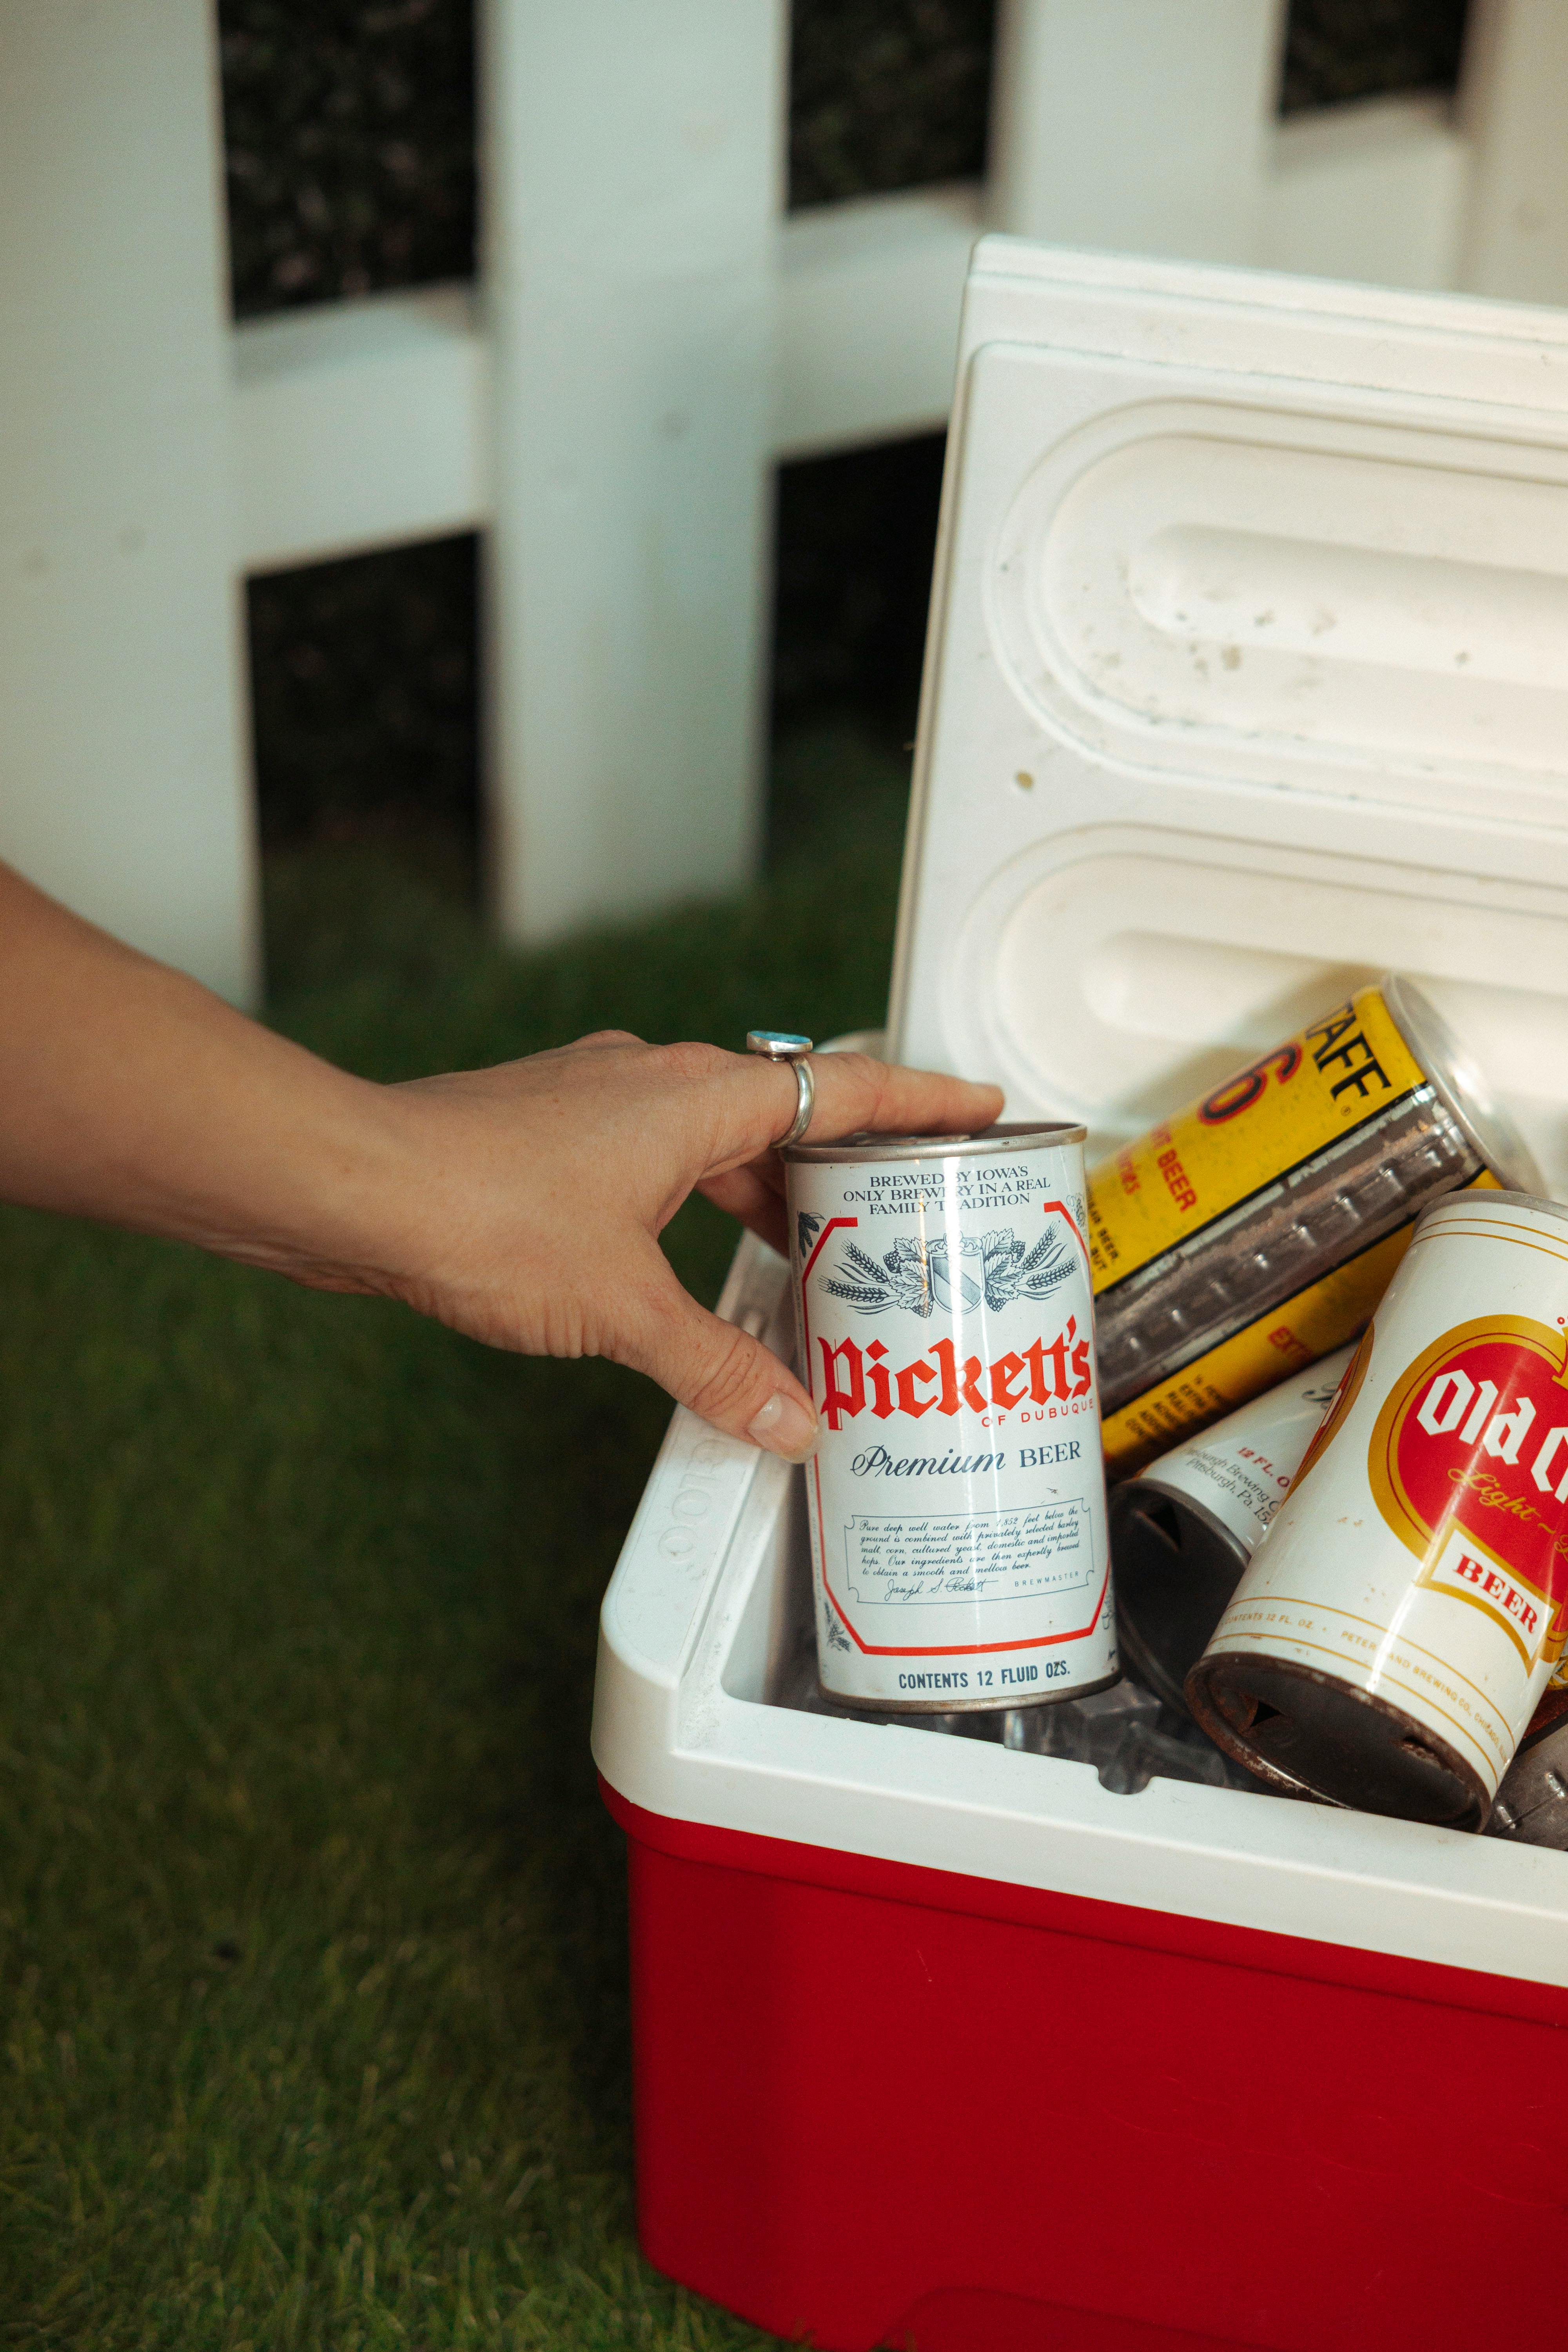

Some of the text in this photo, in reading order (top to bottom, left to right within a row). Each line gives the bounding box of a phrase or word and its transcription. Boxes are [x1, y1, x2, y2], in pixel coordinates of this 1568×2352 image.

[843, 1177, 1051, 1201] ONLY BREWRY IN A REAL
[870, 1173, 945, 1187] BREWED
[977, 1166, 1028, 1181] IOWA'S
[1158, 1148, 1197, 1212] BEER
[869, 1193, 1030, 1215] FAMILY TADITION
[816, 1314, 1092, 1431] Pickett's
[982, 1399, 1094, 1427] OF DUBUQUE
[1416, 1369, 1537, 1465] Old
[850, 1440, 1081, 1478] Premium BEER
[1238, 1447, 1290, 1487] 12 FL. O
[1227, 1464, 1269, 1503] Brewing
[1447, 1466, 1541, 1521] Light
[1237, 1490, 1252, 1508] Pa.
[860, 1519, 879, 1531] Pure
[884, 1523, 903, 1534] deep
[909, 1522, 929, 1531] well
[933, 1522, 960, 1531] water
[965, 1519, 989, 1533] from
[1023, 1513, 1040, 1528] feet
[1045, 1510, 1064, 1520] below
[1068, 1505, 1078, 1515] the
[860, 1535, 890, 1545] ground
[905, 1533, 948, 1543] combined
[952, 1530, 972, 1541] with
[976, 1527, 1021, 1542] privately
[1025, 1522, 1054, 1534] selected
[1057, 1517, 1079, 1529] barley
[861, 1544, 881, 1554] malt,
[912, 1544, 951, 1553] cultured
[987, 1539, 1025, 1550] domestic
[1028, 1535, 1045, 1544] and
[1047, 1528, 1079, 1544] imported
[862, 1555, 880, 1567] hops.
[888, 1555, 906, 1566] Our
[911, 1555, 963, 1569] ingredients
[992, 1551, 1012, 1560] then
[1017, 1545, 1052, 1560] expertly
[1057, 1540, 1079, 1552] brewed
[873, 1567, 898, 1576] obtain
[913, 1566, 944, 1576] smooth
[949, 1566, 970, 1575] and
[976, 1563, 1007, 1573] mellow
[1012, 1561, 1031, 1569] beer.
[1014, 1571, 1078, 1587] BREWMASTER
[1452, 1553, 1537, 1634] BEER
[899, 1660, 1071, 1689] CONTENTS 12 FLUID OZS.
[1341, 1631, 1376, 1652] PETER
[1388, 1652, 1411, 1668] AND
[1412, 1666, 1457, 1702] BREWING
